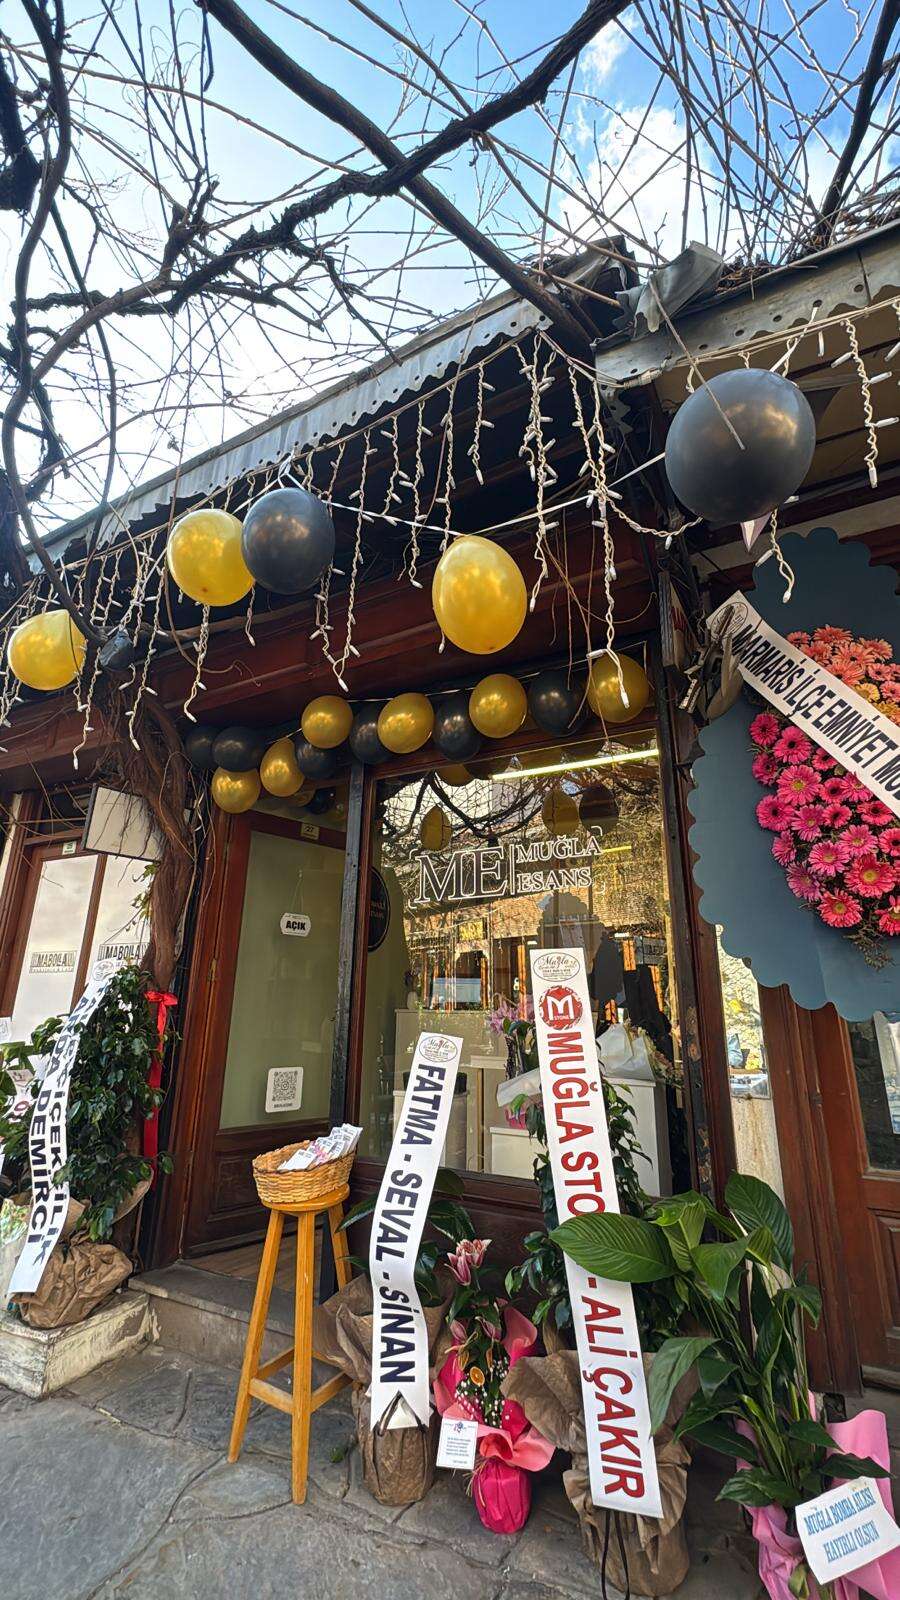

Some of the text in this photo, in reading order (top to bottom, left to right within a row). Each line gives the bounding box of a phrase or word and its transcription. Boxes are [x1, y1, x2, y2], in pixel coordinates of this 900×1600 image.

[783, 668, 836, 719] İLÇE
[812, 698, 899, 769] EMNİYET
[414, 846, 508, 903] ME
[516, 835, 602, 864] MUĞLA
[517, 866, 592, 893] ESANS
[286, 921, 306, 931] AÇIK
[400, 1064, 447, 1145] FATMA
[547, 1031, 598, 1144] MUĞLA
[28, 1089, 53, 1244] DEMİRCİ
[561, 1151, 606, 1217] STO
[376, 1169, 423, 1262] SEVAL
[379, 1286, 420, 1383] SİNAN
[582, 1296, 638, 1359] ALİ
[582, 1367, 645, 1499] ÇAKIR
[804, 1507, 834, 1536] MUĞLA
[823, 1519, 880, 1563] HAYIRLI OLSUN
